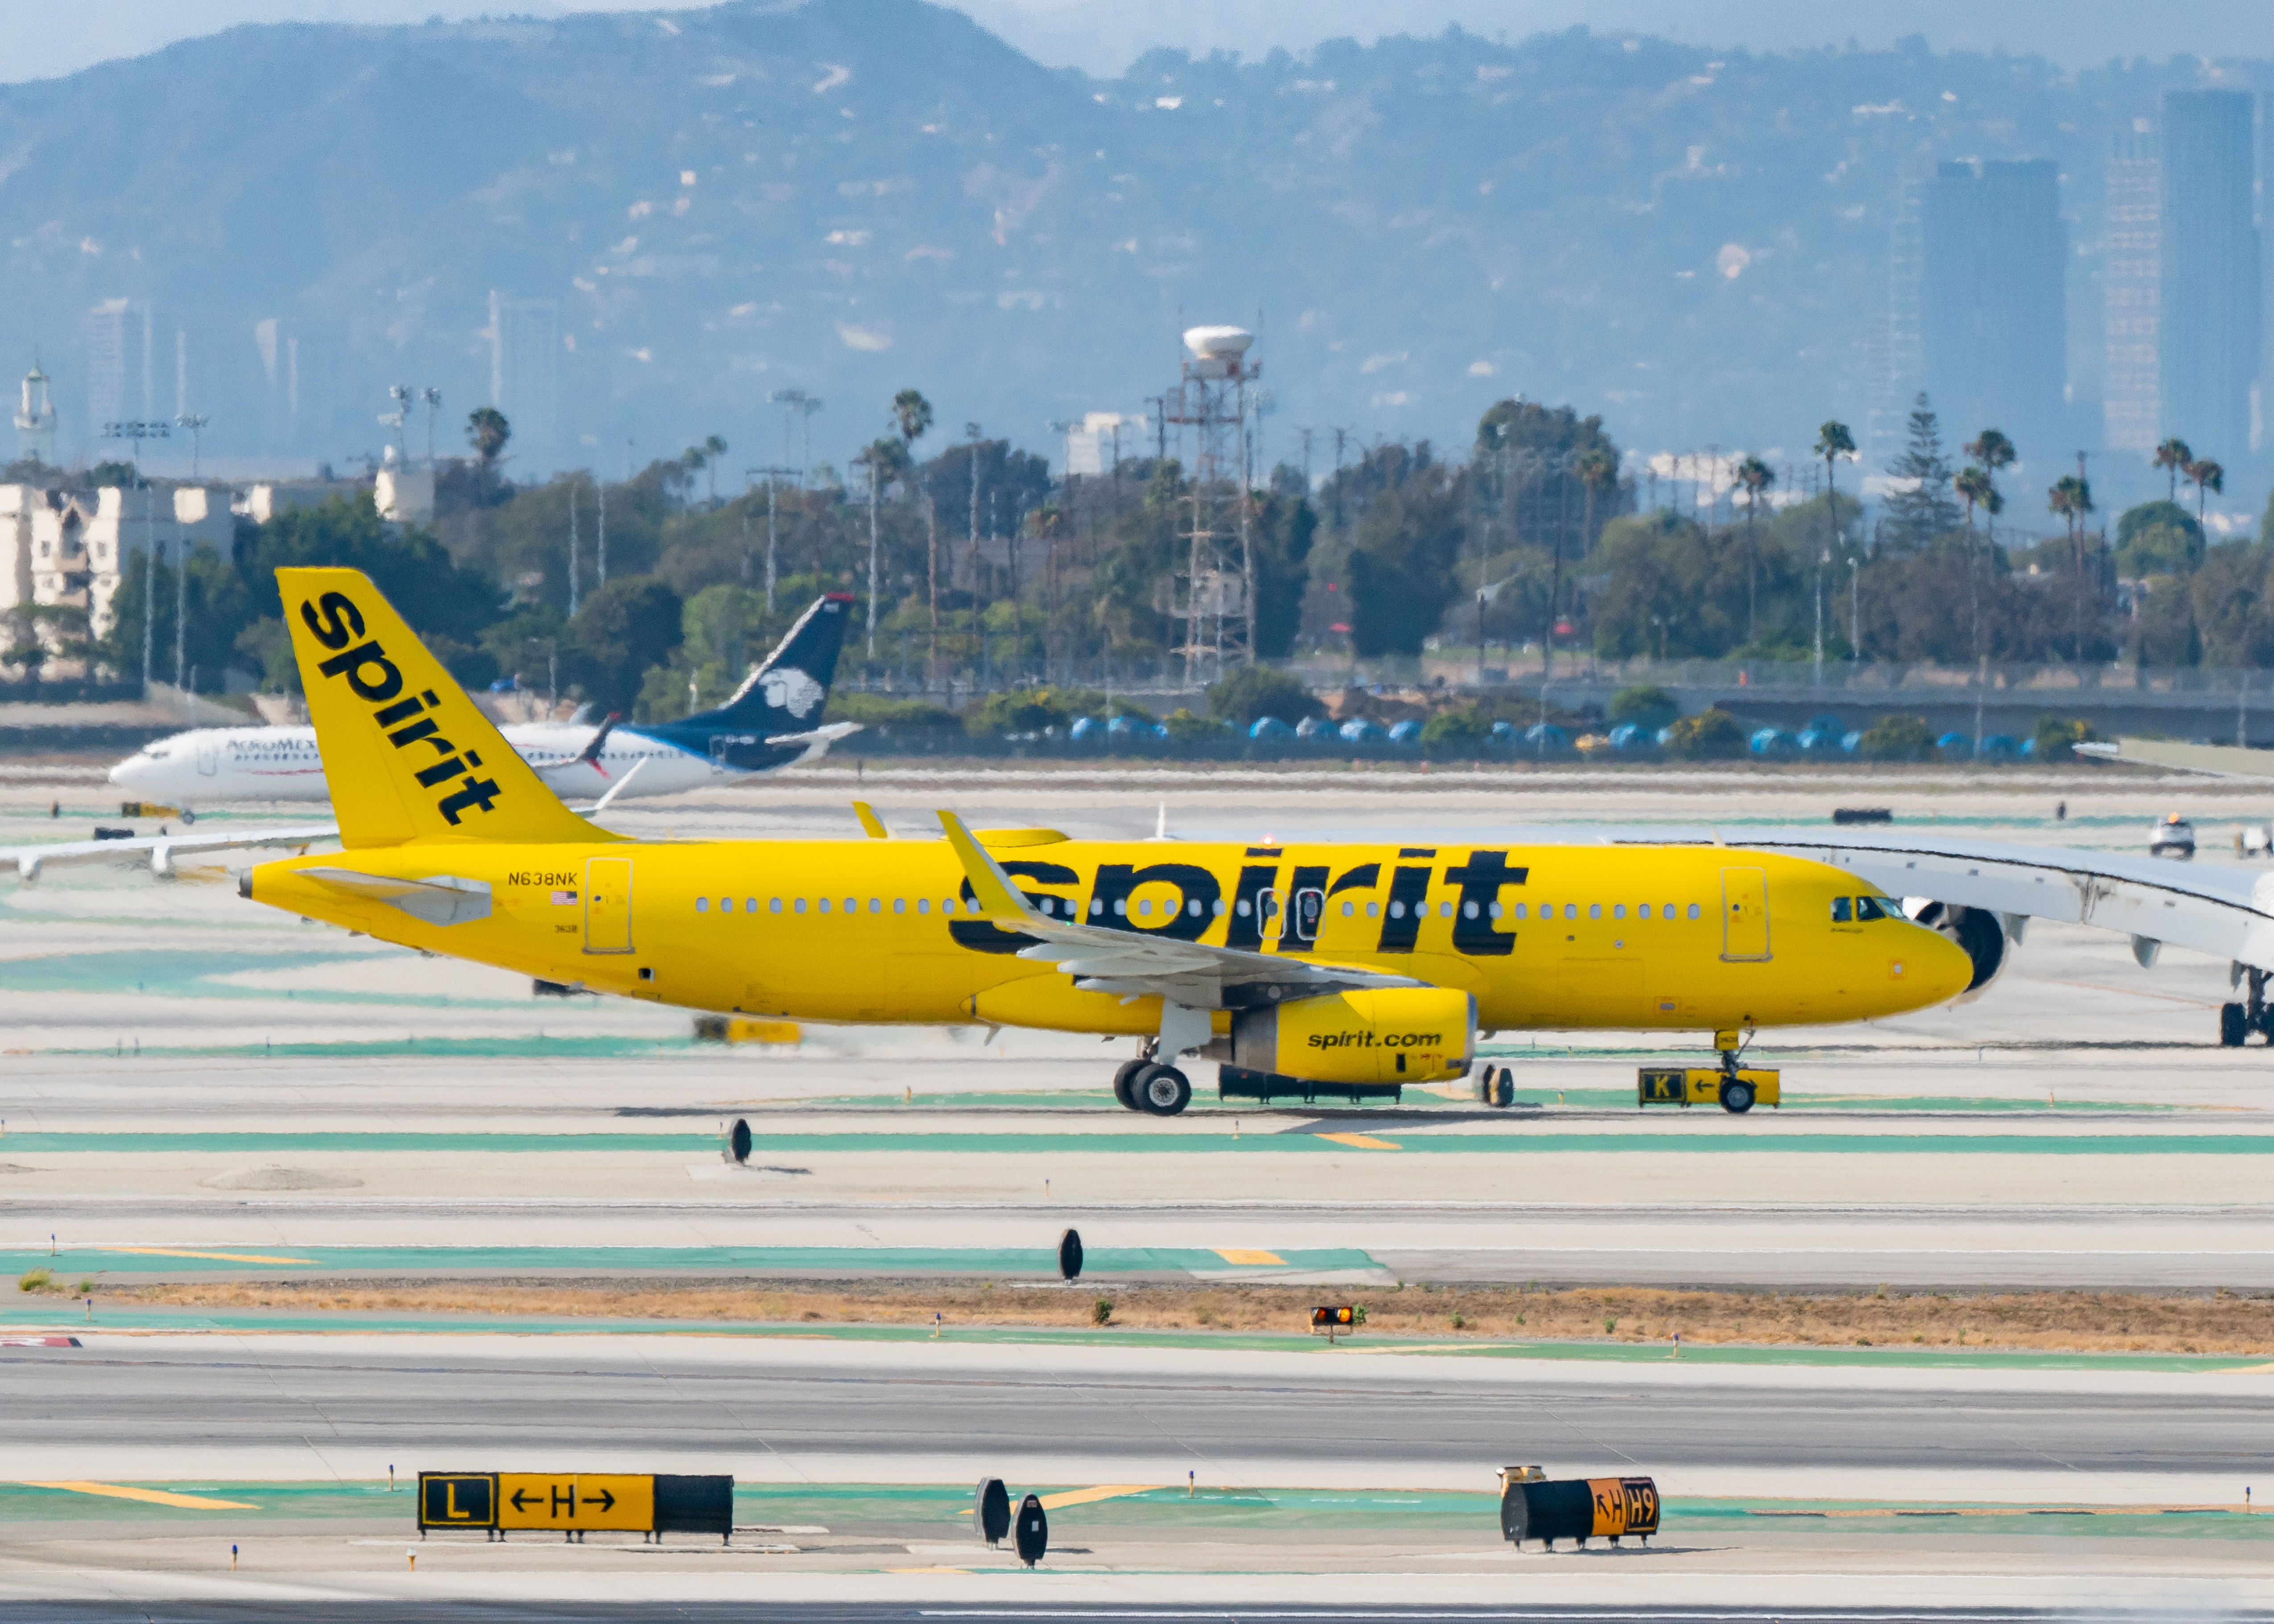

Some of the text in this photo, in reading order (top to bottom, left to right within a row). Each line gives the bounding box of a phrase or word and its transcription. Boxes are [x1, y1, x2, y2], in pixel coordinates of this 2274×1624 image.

[301, 592, 501, 826] spirit
[508, 872, 577, 885] N638NK
[948, 847, 1529, 985] spirit
[1308, 1030, 1442, 1050] spirit.com
[1653, 1075, 1670, 1097] K
[447, 1483, 575, 1518] L H
[1608, 1488, 1653, 1523] H H9
